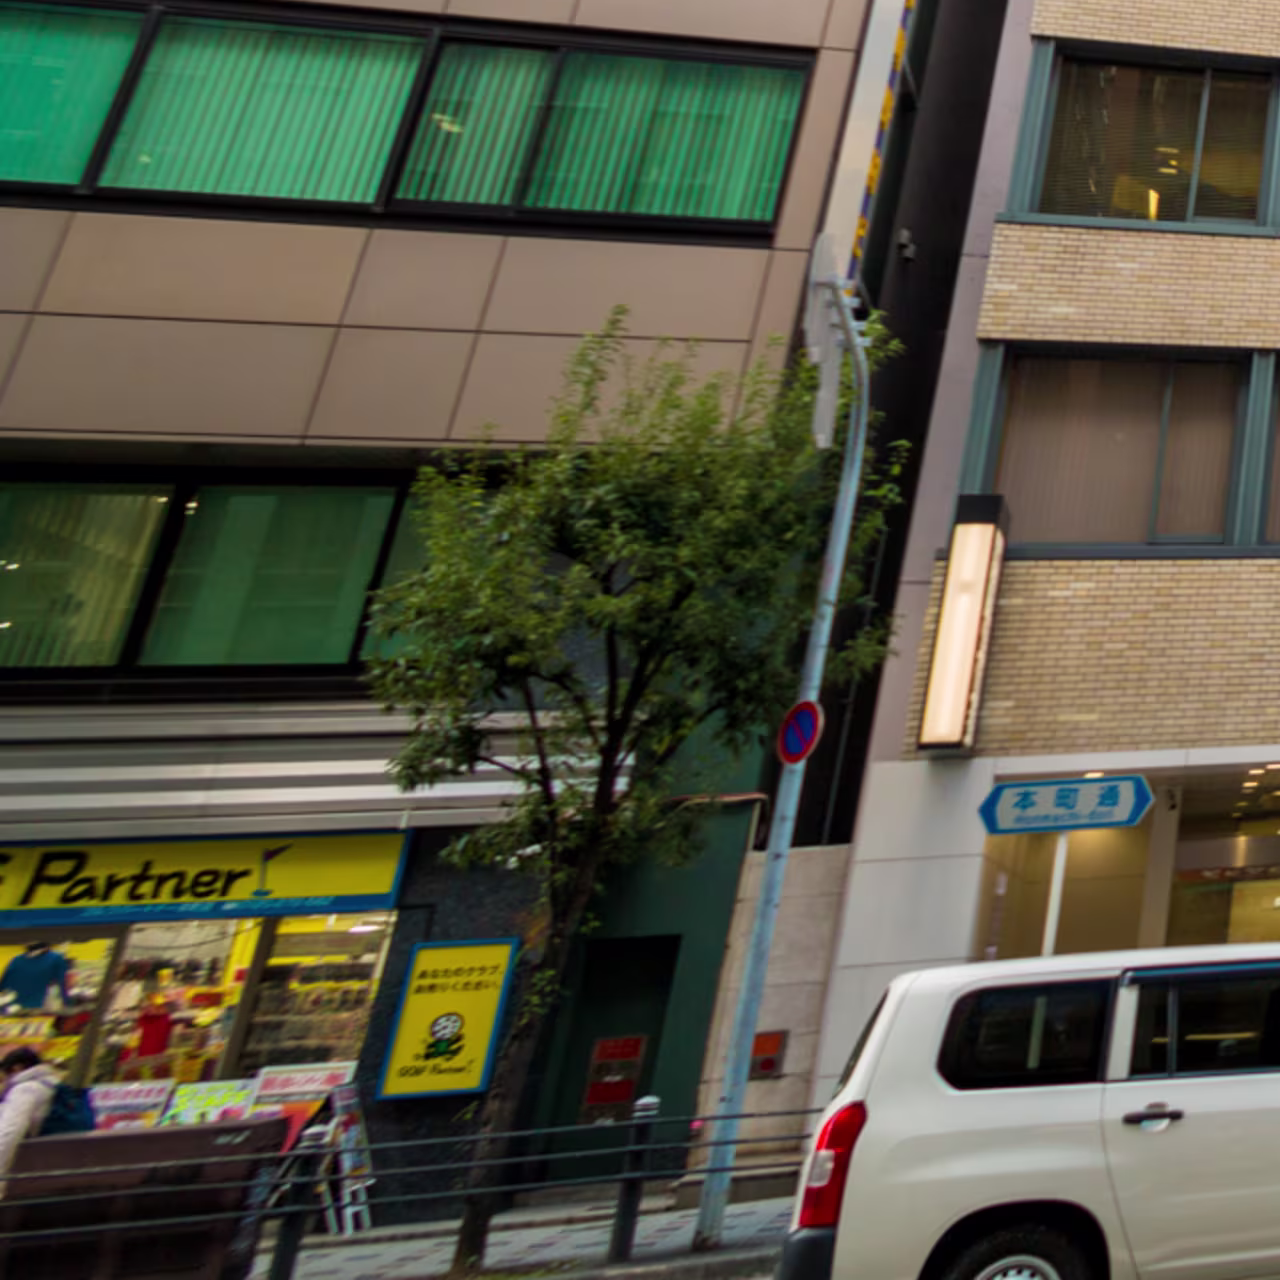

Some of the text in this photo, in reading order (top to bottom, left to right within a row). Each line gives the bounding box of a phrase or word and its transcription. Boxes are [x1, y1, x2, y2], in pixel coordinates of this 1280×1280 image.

[1012, 784, 1120, 811] 本町通
[18, 850, 254, 906] Partner
